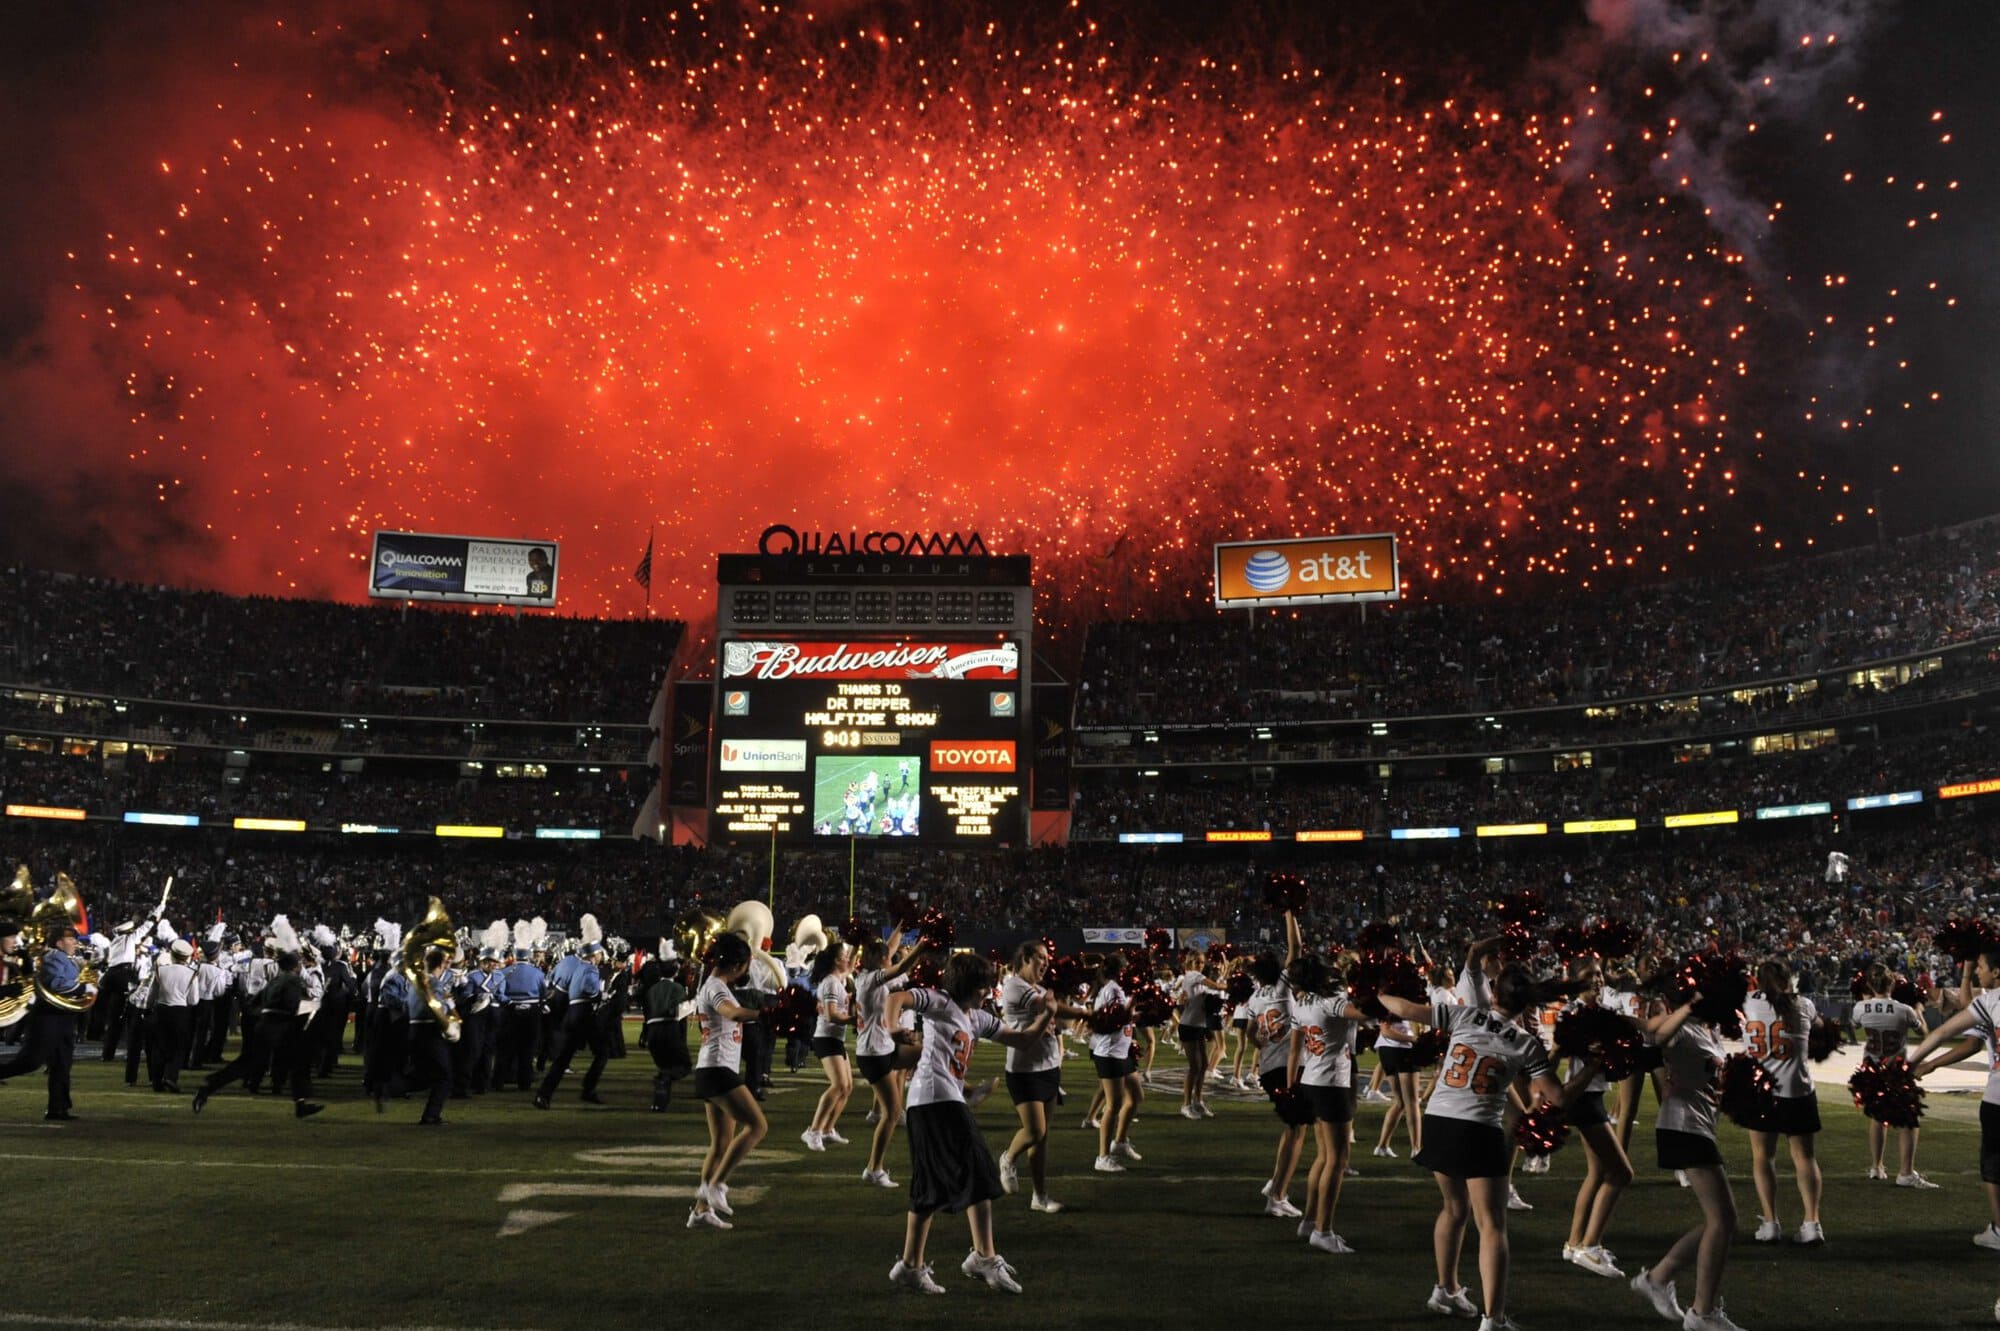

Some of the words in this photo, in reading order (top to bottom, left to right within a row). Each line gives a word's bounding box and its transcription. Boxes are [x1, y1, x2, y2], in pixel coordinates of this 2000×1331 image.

[759, 525, 989, 556] QUALCOMM
[380, 549, 462, 568] QUALCOMM
[471, 556, 527, 566] POMERADO
[470, 565, 526, 575] HEALTH
[807, 563, 969, 574] STADIUM
[1299, 550, 1372, 582] at&t
[750, 642, 948, 679] Budweiser
[950, 655, 989, 674] American
[991, 653, 1016, 664] Lager
[838, 684, 881, 695] THANKS
[885, 684, 901, 695] TO
[827, 698, 848, 710] DR
[854, 698, 910, 710] PEPPER
[805, 713, 886, 726] HALFTIME
[895, 713, 937, 726] SHOW
[674, 743, 706, 755] Sprint
[743, 751, 804, 761] UnionBank
[935, 749, 1012, 765] TOYOTA
[772, 785, 784, 793] TO
[930, 786, 948, 795] THE
[951, 786, 992, 796] PACIFIC
[994, 786, 1018, 795] LIFE
[1940, 784, 1978, 799] WELLS
[1209, 832, 1239, 842] WELLS
[1240, 831, 1271, 842] FARGO
[1864, 1003, 1895, 1014] BGA
[1473, 1011, 1518, 1042] BGA
[1745, 1020, 1793, 1061] 36
[1444, 1043, 1506, 1096] 36
